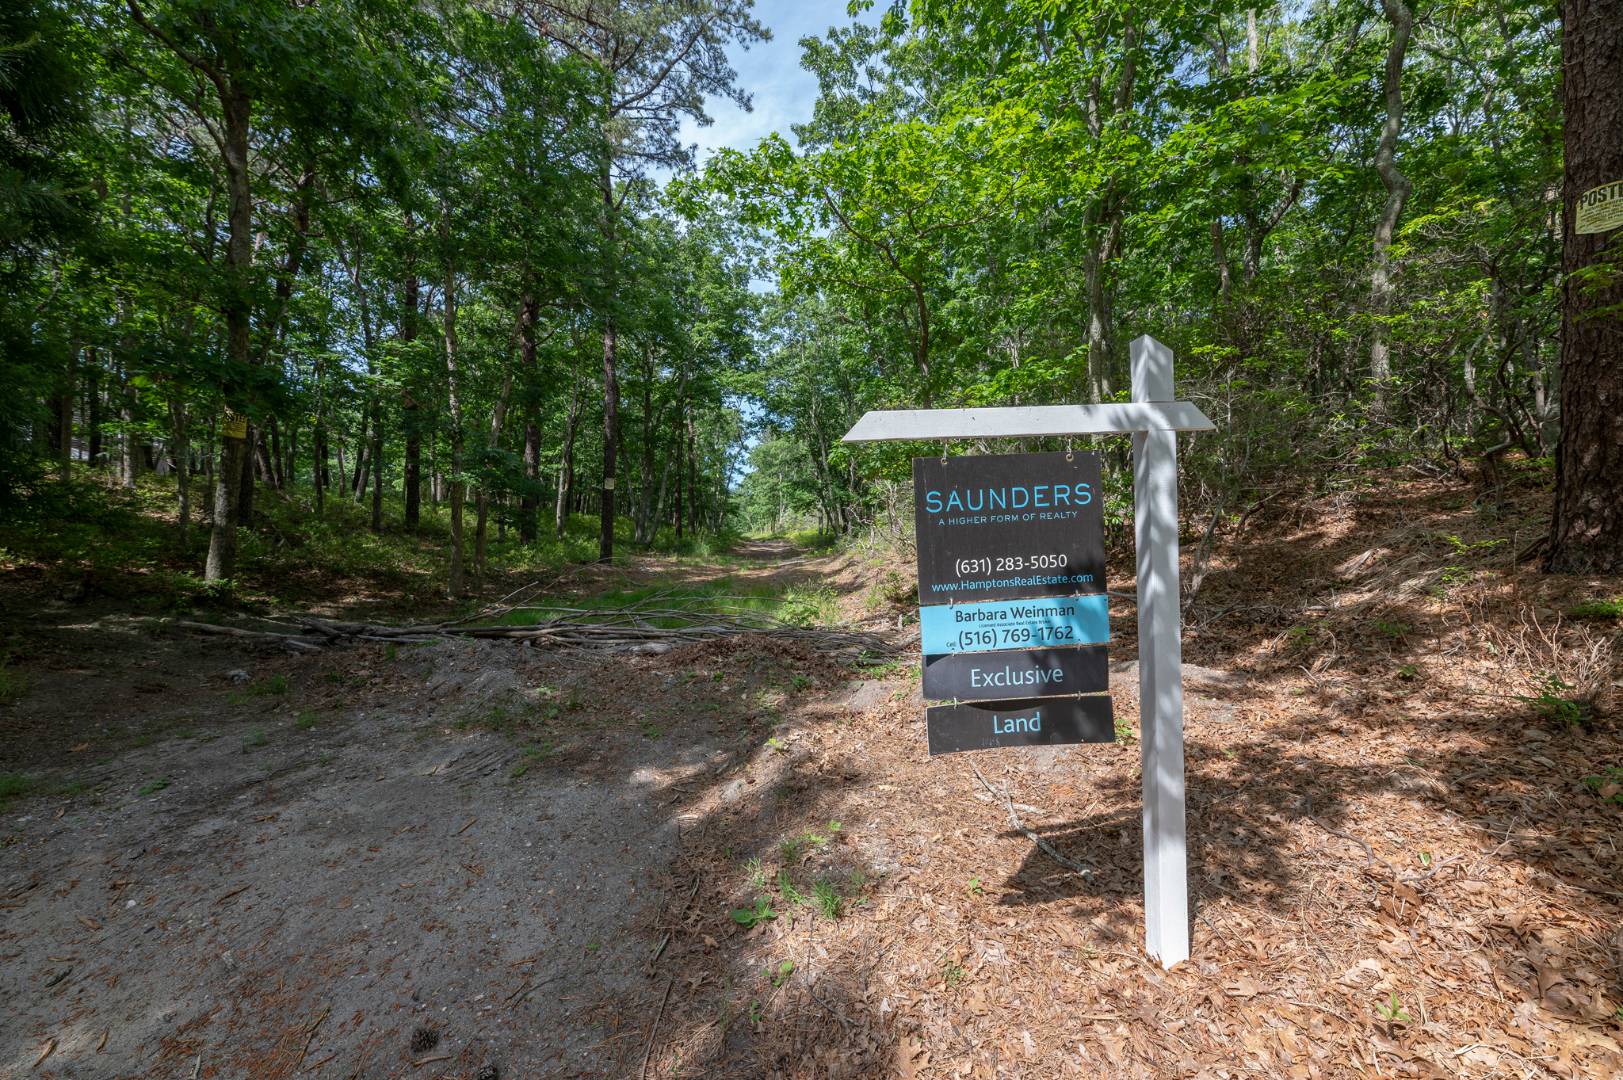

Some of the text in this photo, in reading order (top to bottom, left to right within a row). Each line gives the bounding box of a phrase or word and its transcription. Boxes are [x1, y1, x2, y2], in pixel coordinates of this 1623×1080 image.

[925, 482, 1092, 514] SAUNDERS
[938, 511, 1078, 526] A HIGHER FORM OF REALTY
[955, 554, 1068, 578] (631) 283-5050
[931, 573, 1094, 593] www.HamptonsRealEstate.com
[955, 606, 1075, 623] Barbara Weinman
[959, 628, 997, 650] (516)
[1002, 625, 1074, 644] 769-1762
[970, 665, 1064, 688] Exclusive
[993, 712, 1041, 735] Land
